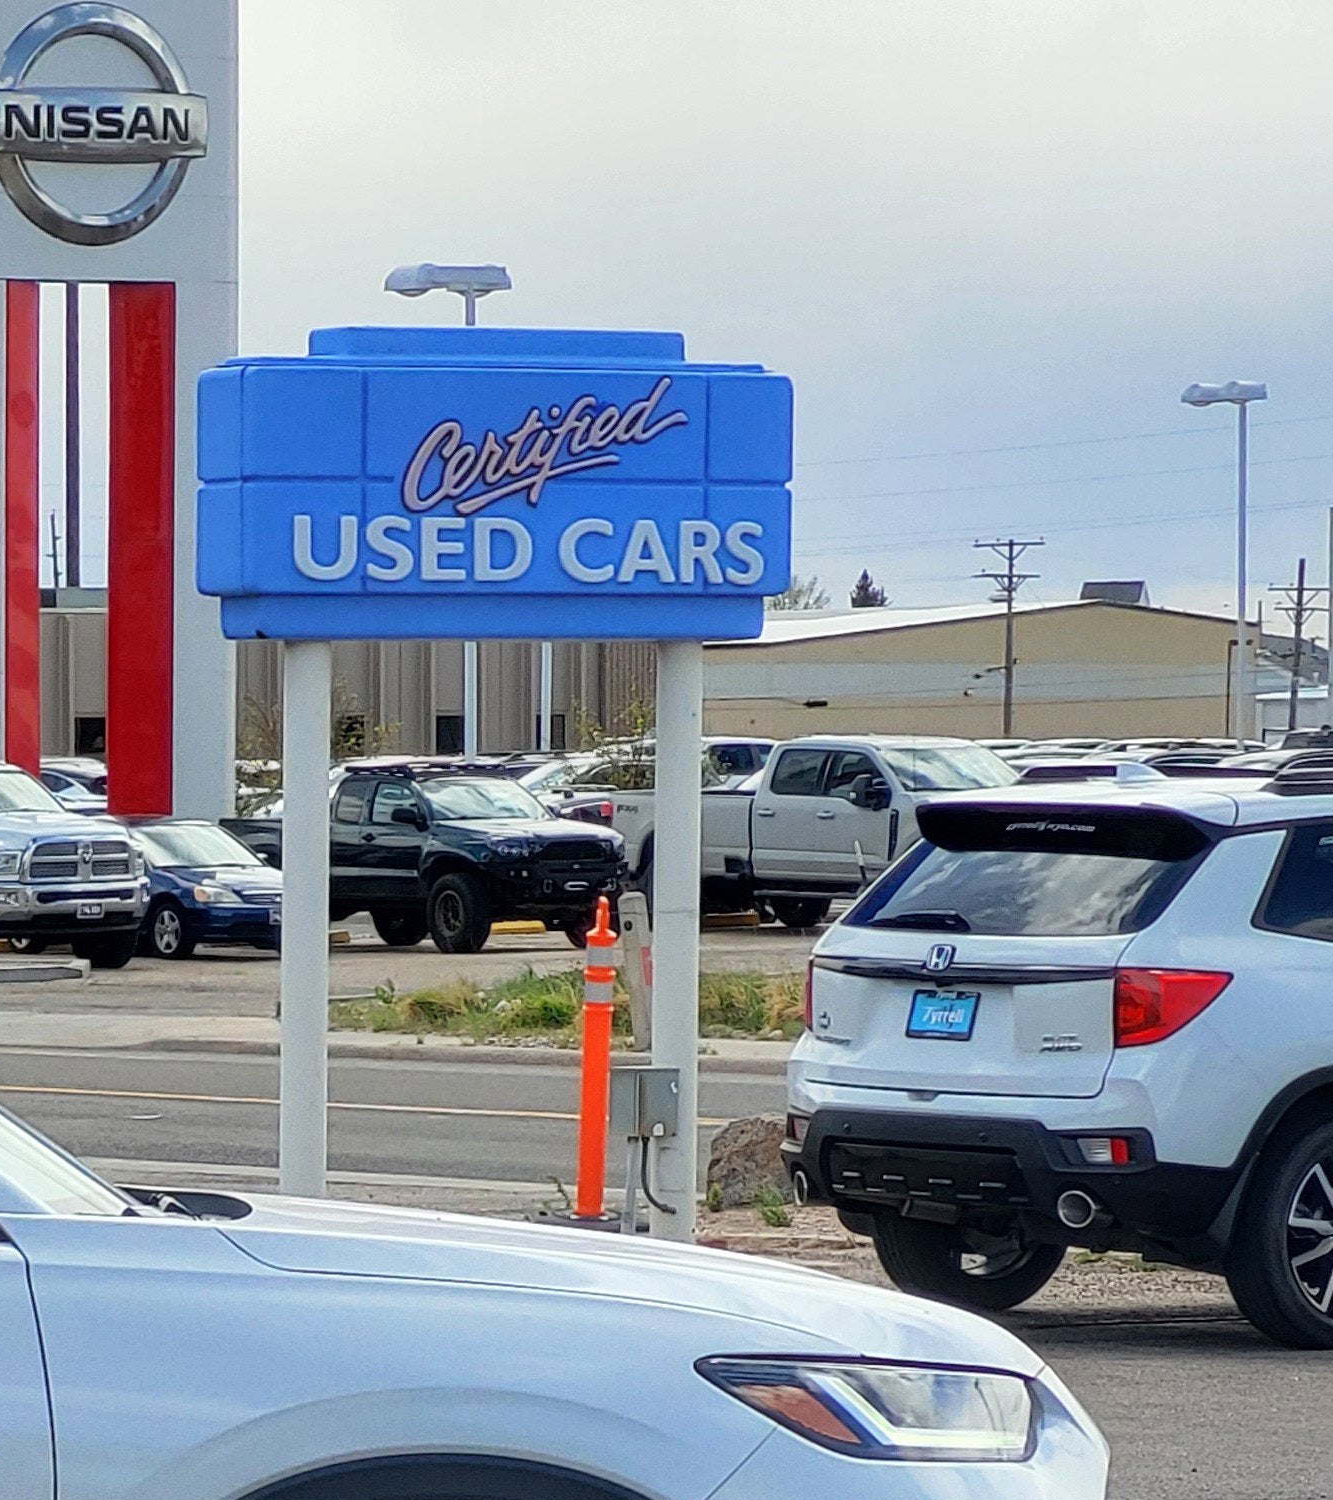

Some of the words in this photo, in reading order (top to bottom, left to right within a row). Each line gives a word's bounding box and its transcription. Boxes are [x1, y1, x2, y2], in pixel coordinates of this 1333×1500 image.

[4, 103, 191, 143] NISSAN
[401, 375, 689, 513] Certified
[293, 514, 533, 583] USED
[558, 518, 765, 586] CARS
[922, 1006, 965, 1025] Tyrrell
